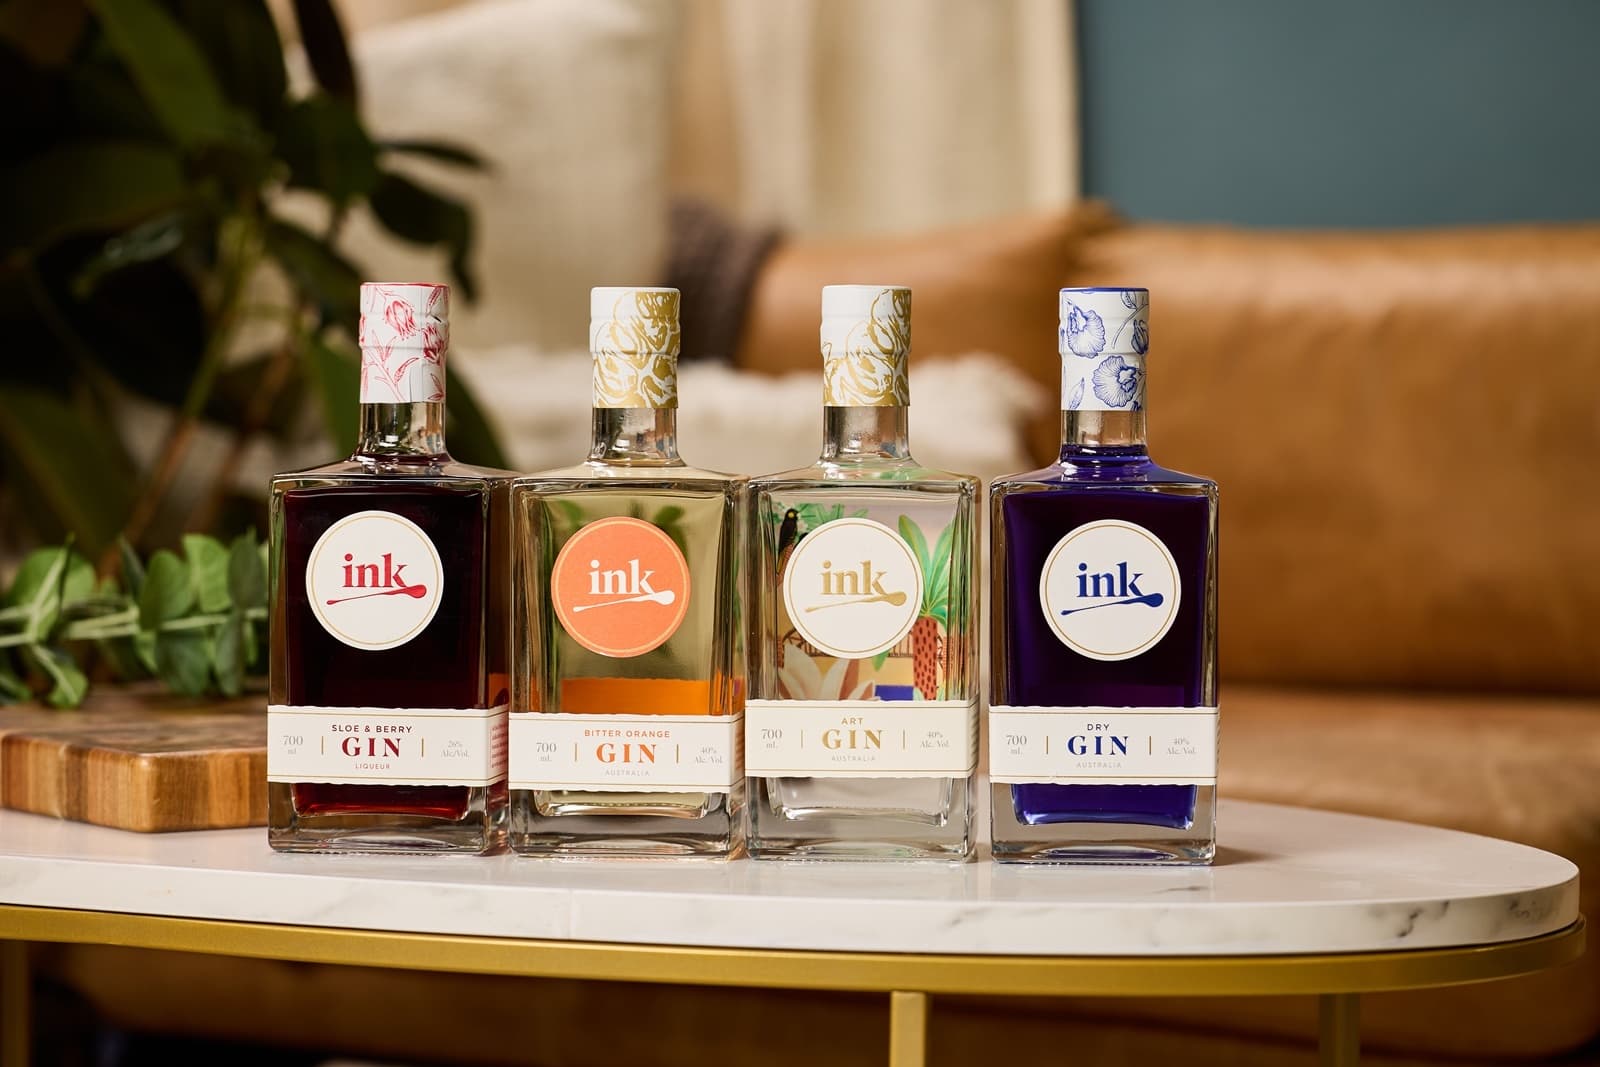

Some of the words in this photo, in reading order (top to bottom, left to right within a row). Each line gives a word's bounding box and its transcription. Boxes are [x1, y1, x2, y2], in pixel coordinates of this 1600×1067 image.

[342, 553, 409, 590] ink
[590, 559, 656, 596] ink
[820, 560, 888, 597] ink
[1076, 562, 1146, 598] ink
[841, 717, 864, 725] ART
[332, 724, 360, 733] SLOE
[364, 725, 371, 733] &
[375, 725, 414, 734] BERRY
[1087, 723, 1110, 732] DRY
[584, 729, 622, 737] BITTER
[626, 730, 670, 738] ORANGE
[761, 729, 783, 740] 700
[926, 731, 943, 740] 40%
[282, 735, 304, 746] 700
[821, 729, 883, 750] GIN
[1005, 734, 1028, 746] 700
[1173, 737, 1190, 746] 40%
[341, 736, 402, 758] GIN
[536, 742, 557, 753] 700
[700, 746, 717, 755] 40%
[1068, 735, 1130, 756] GIN
[596, 742, 657, 764] GIN
[1077, 761, 1122, 769] AUSTRALIA
[604, 769, 650, 777] AUSTRALIA
